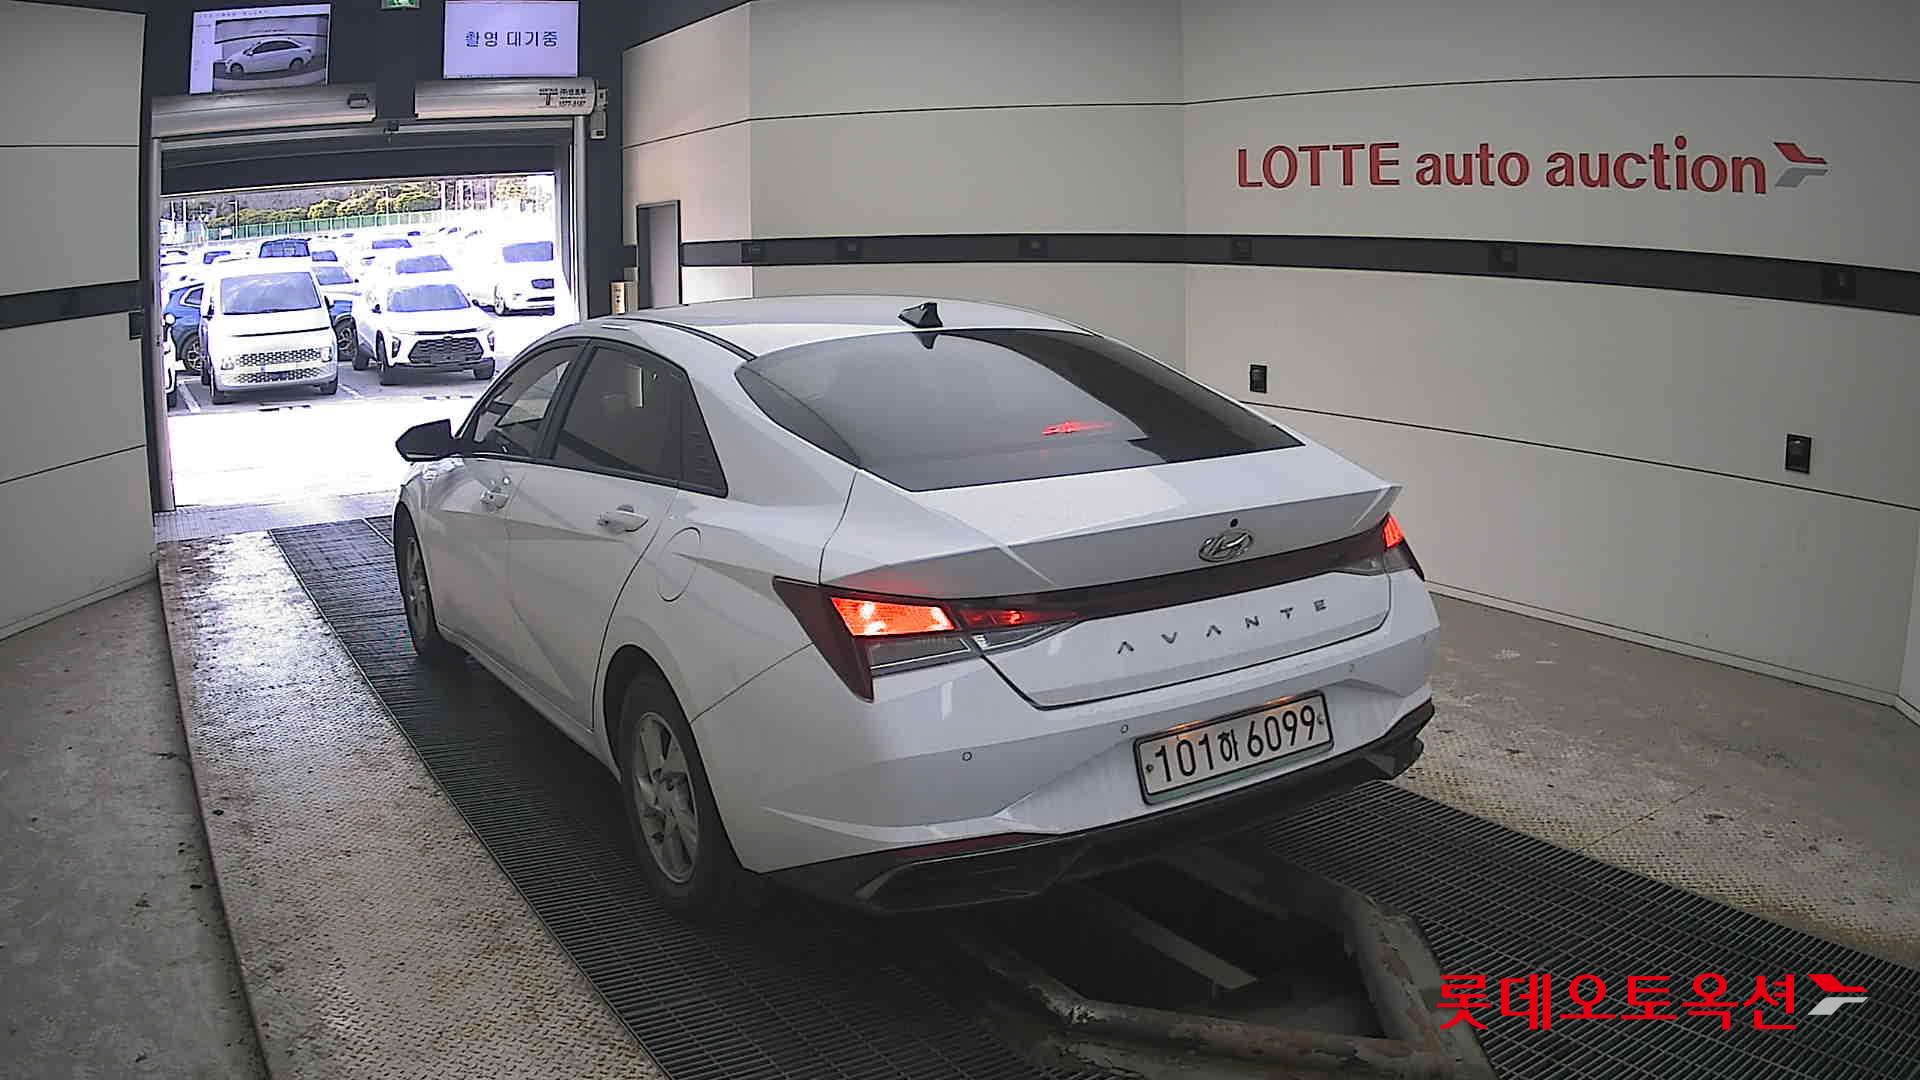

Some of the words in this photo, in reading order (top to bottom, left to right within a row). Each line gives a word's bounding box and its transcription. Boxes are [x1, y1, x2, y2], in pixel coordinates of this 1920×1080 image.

[506, 31, 558, 47] 대기중
[1238, 142, 1400, 189] LOTTE
[1416, 143, 1531, 187] auto
[1545, 135, 1767, 194] auction
[1117, 599, 1328, 655] AVANTE
[1246, 704, 1316, 758] 6099
